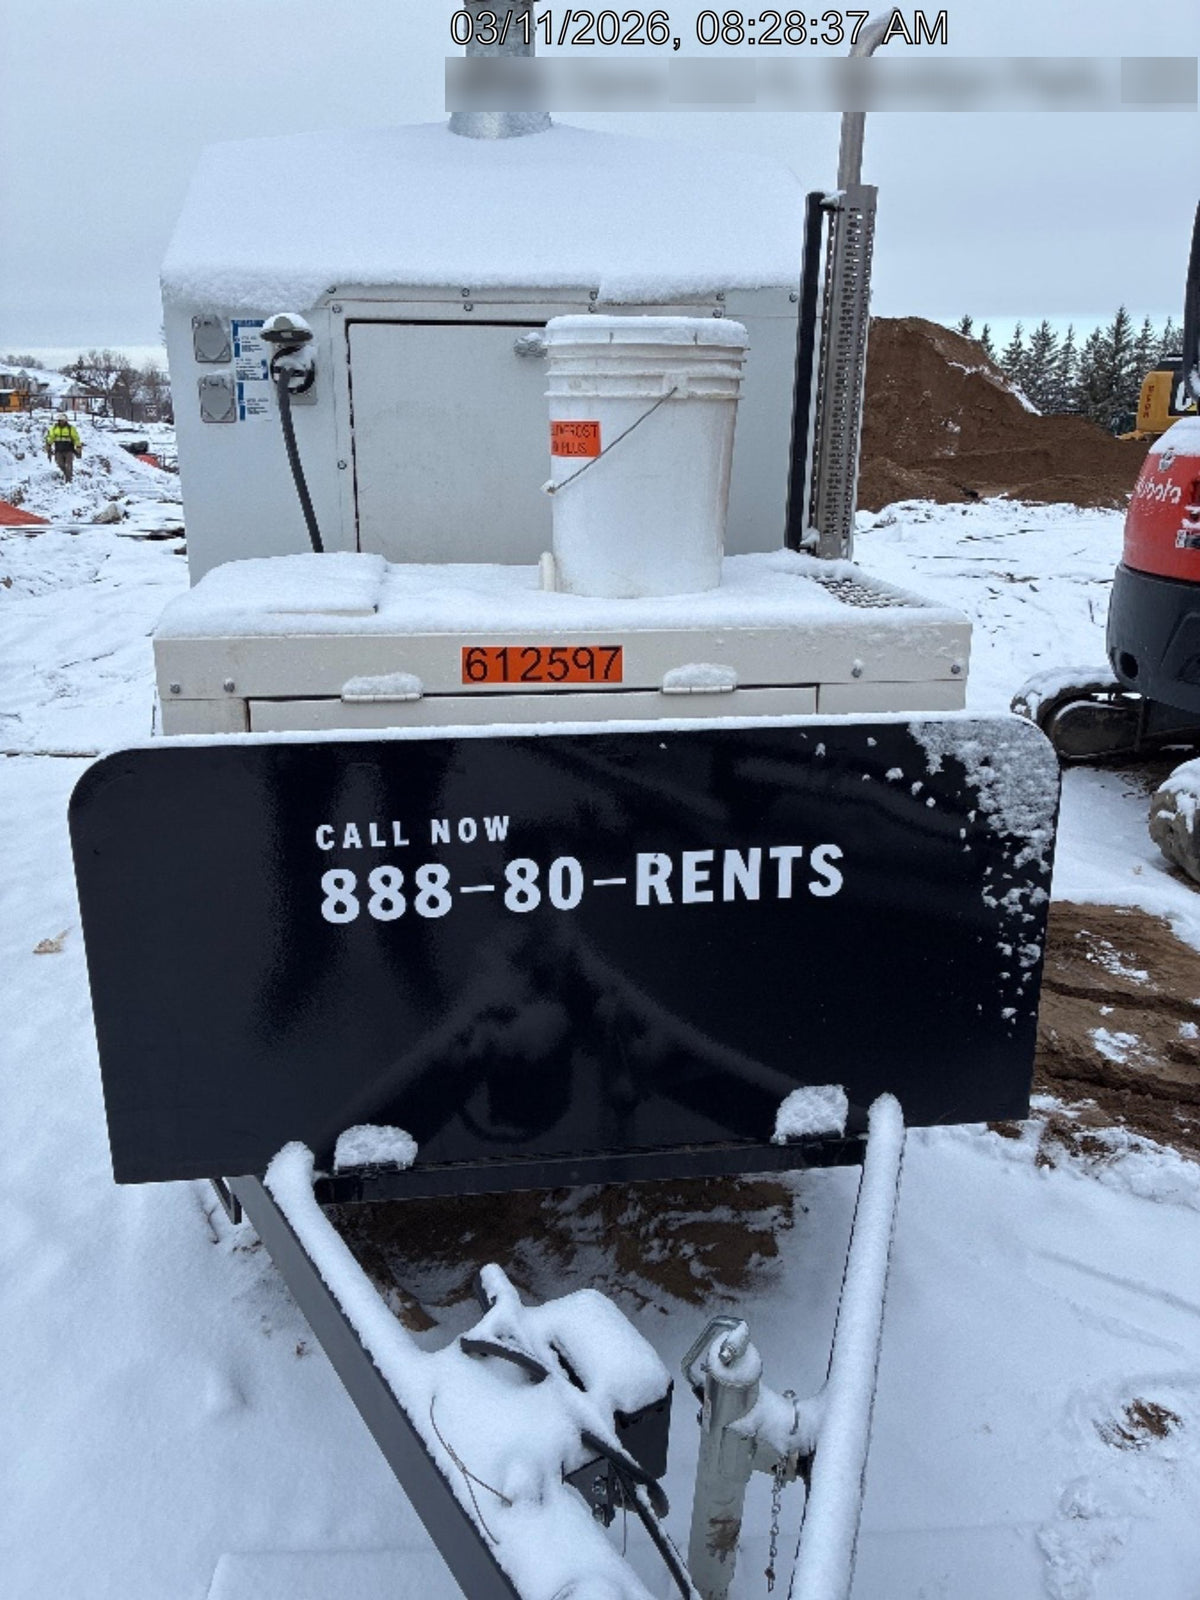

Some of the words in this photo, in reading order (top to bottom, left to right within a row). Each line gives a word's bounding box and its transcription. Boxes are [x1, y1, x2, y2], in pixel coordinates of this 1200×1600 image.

[464, 646, 623, 682] 612597
[315, 820, 411, 851] CALL
[431, 815, 511, 845] NOW
[321, 843, 845, 924] 888-80-RENTS
